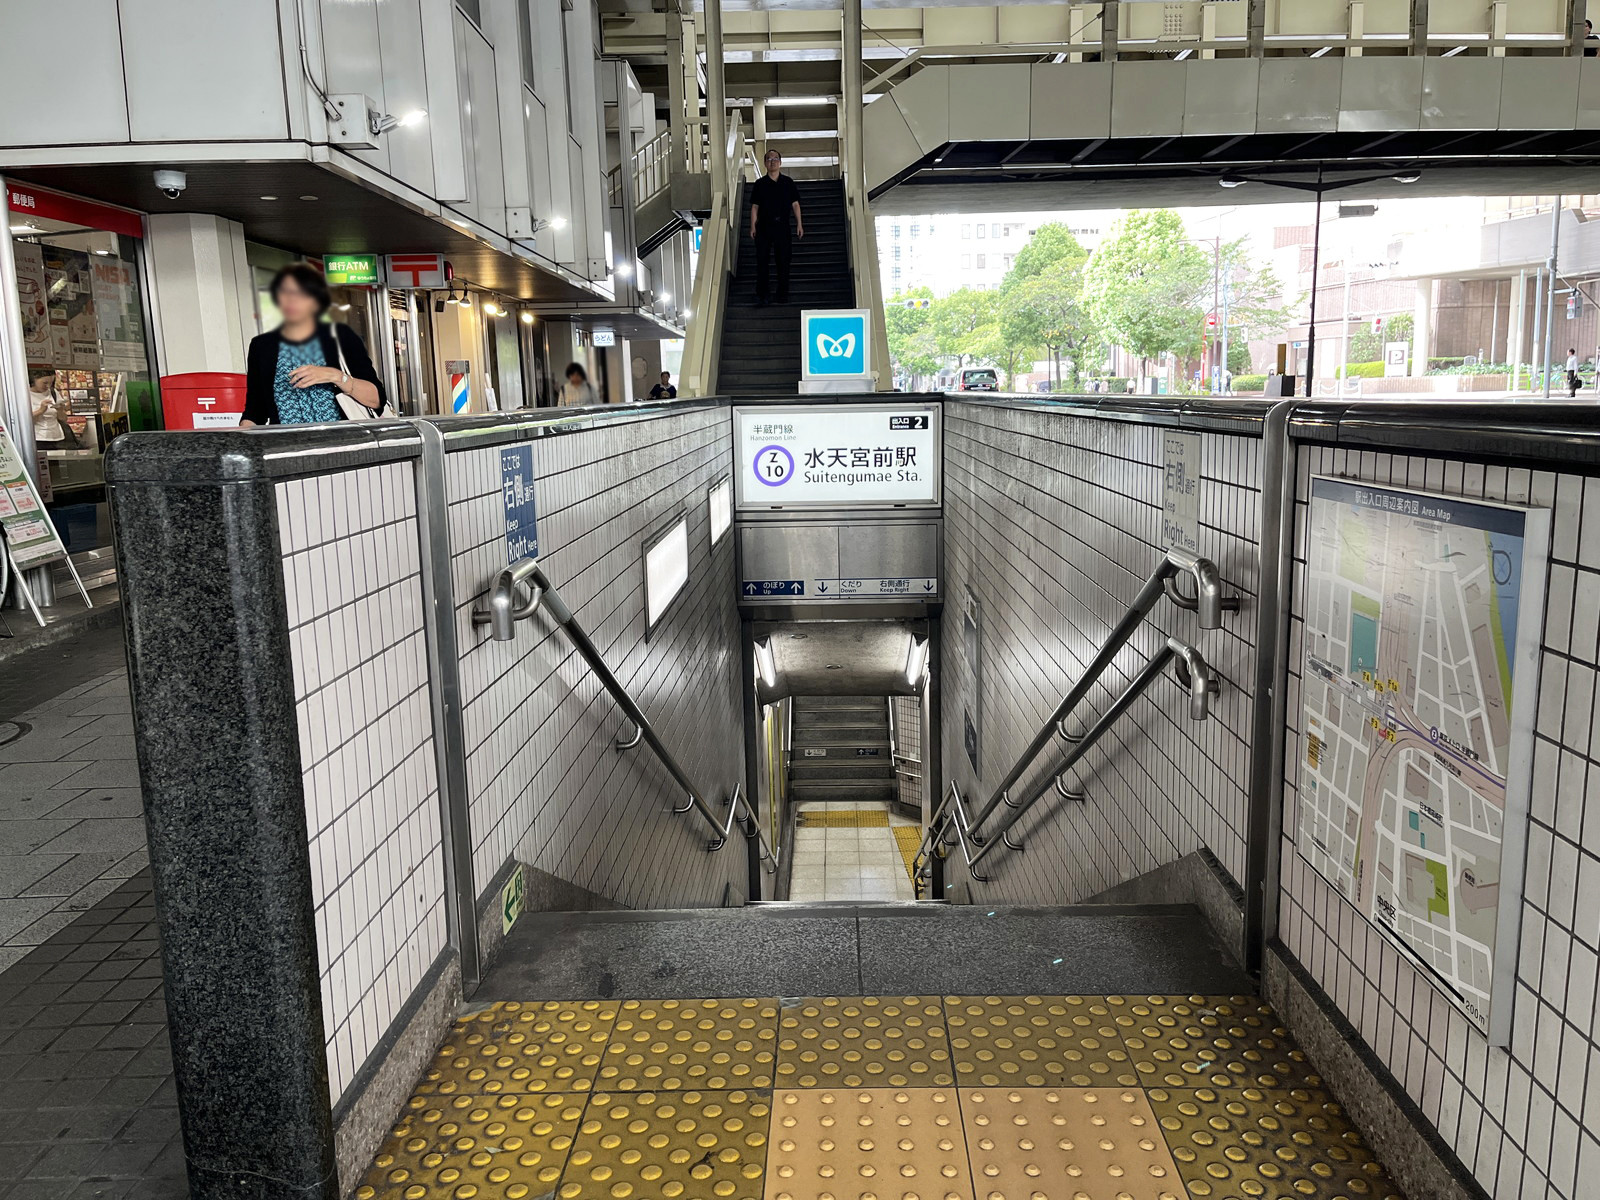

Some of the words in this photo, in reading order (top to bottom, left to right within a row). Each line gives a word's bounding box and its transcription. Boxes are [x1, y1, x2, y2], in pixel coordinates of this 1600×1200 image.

[12, 192, 36, 209] 郵便局
[328, 261, 369, 271] 銀行ATM
[594, 334, 613, 342] うどん
[891, 417, 910, 425] 出入口
[914, 416, 923, 429] 2
[753, 424, 794, 434] 半蔵門線
[502, 454, 521, 472] ここでは
[769, 452, 779, 463] Z
[804, 447, 917, 468] 水天宮前駅
[766, 465, 784, 478] 10
[804, 470, 892, 485] Suitengumae
[897, 470, 922, 481] Sta.
[1165, 498, 1175, 514] Keep
[1355, 490, 1419, 515] 駅出入口周辺案内図
[1421, 506, 1436, 518] Area
[1436, 509, 1451, 522] Map
[506, 519, 519, 533] Keep
[1164, 518, 1183, 547] Right
[508, 535, 528, 563] Right
[763, 581, 785, 589] のぼり
[841, 580, 862, 588] くだり
[880, 579, 910, 588] 右側通行
[1377, 894, 1396, 920] 中央区
[1465, 1000, 1486, 1025] 200m
